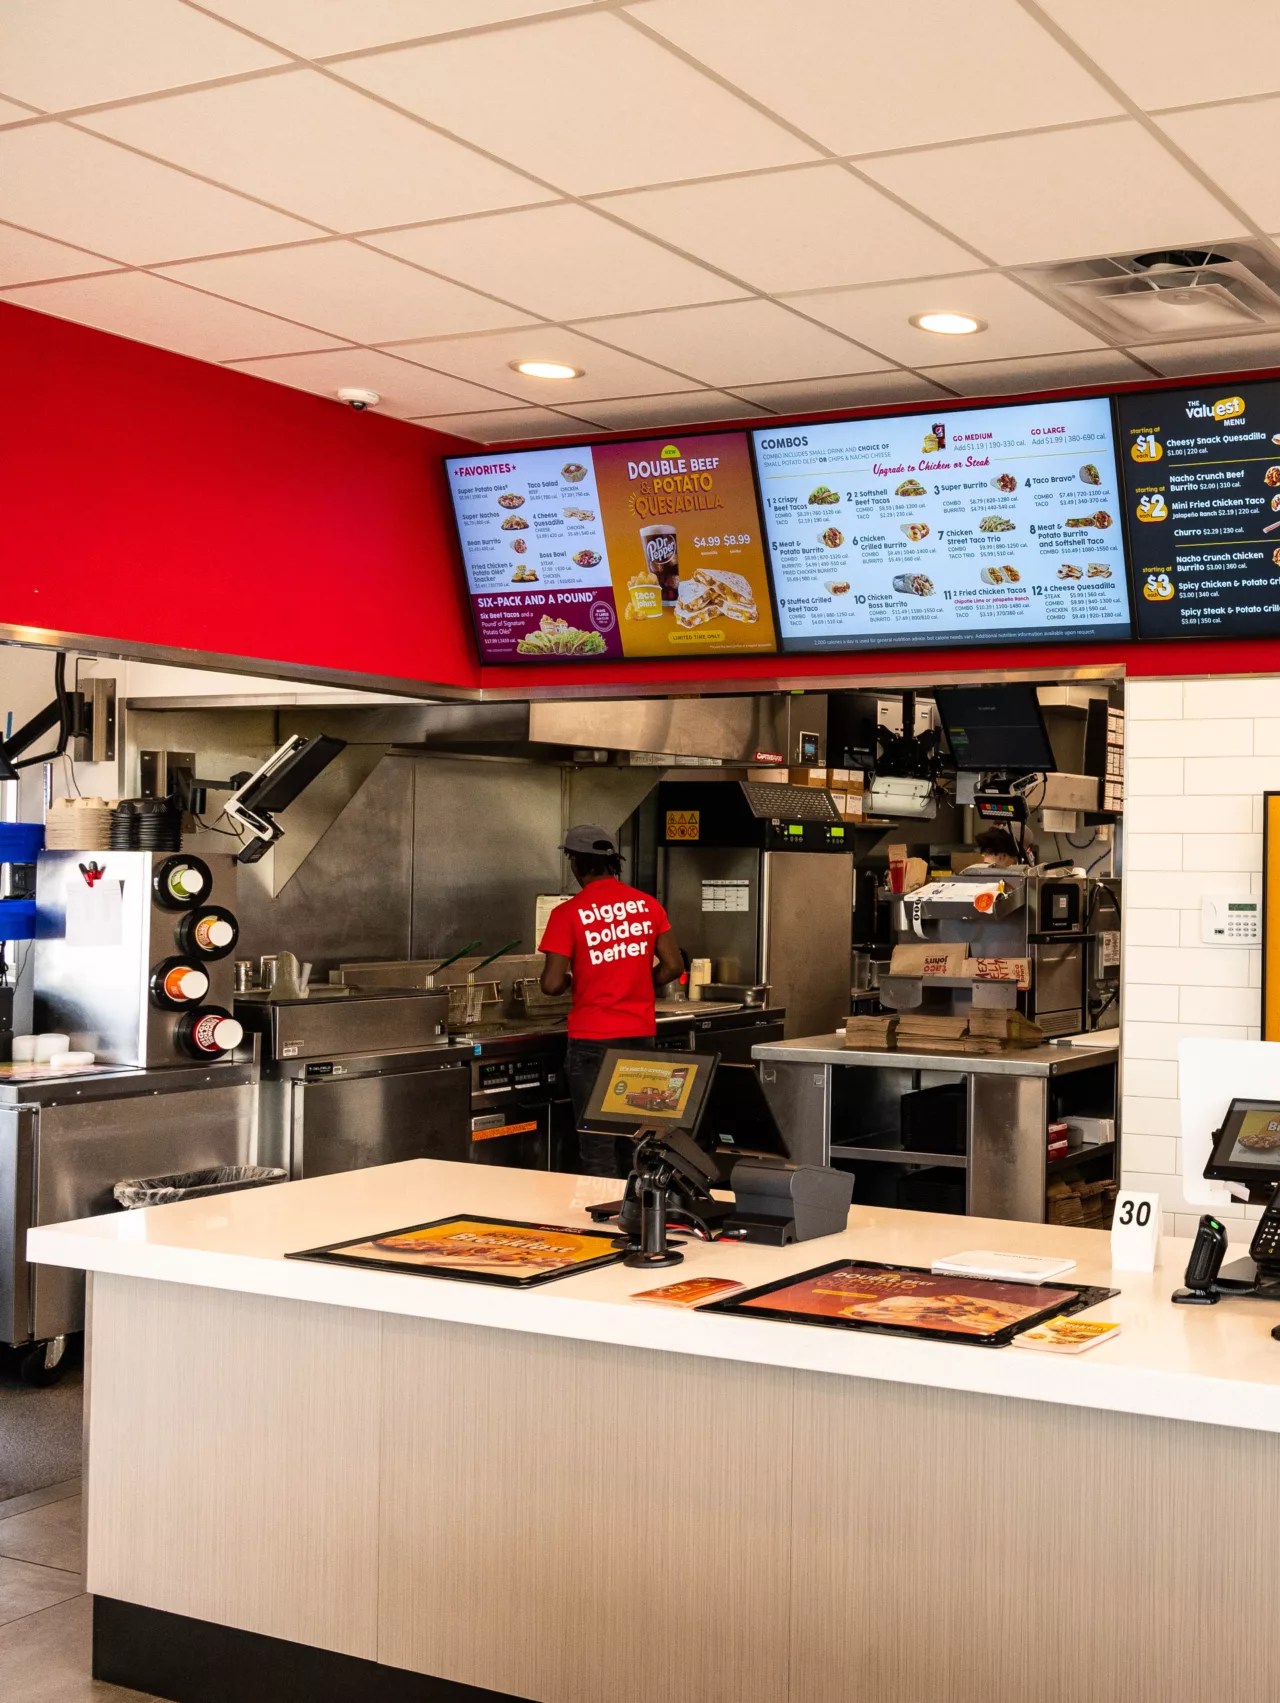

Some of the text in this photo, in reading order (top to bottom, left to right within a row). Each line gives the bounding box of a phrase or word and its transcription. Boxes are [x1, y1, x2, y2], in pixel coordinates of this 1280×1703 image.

[761, 436, 808, 449] COMBOS
[965, 433, 992, 441] MEDIUM
[1167, 432, 1266, 447] Cheesy Snack Quesadilla
[1137, 435, 1156, 458] $1
[460, 463, 511, 477] FAVORITES
[628, 458, 719, 479] DOUBLE BEEF
[873, 463, 905, 477] Upgrade
[907, 464, 916, 472] to
[918, 460, 951, 471] Chicken
[965, 456, 990, 468] Steak
[1196, 472, 1224, 481] Crunch
[1227, 470, 1244, 478] Beef
[641, 473, 713, 494] & POTATO
[934, 485, 940, 495] 3
[941, 483, 962, 492] Super
[1025, 478, 1031, 488] 4
[1171, 483, 1198, 492] Burrito
[635, 495, 723, 518] QUESADILLA
[767, 498, 772, 507] 1
[1141, 494, 1166, 518] $2
[1172, 497, 1265, 510] Mini Fried Chicken Taco
[656, 538, 667, 549] Dr
[694, 534, 750, 547] $4.99 $8.99
[1176, 552, 1263, 563] Nacho Crunch Chicken
[1032, 586, 1042, 595] 12
[1077, 582, 1115, 590] Quesadilla
[1148, 574, 1170, 596] $3
[1179, 582, 1199, 590] Spicy
[1201, 580, 1232, 588] Chicken
[1242, 579, 1268, 587] Potato
[478, 596, 522, 607] SIX-PACK
[525, 595, 545, 605] AND
[548, 594, 556, 603] A
[578, 900, 649, 926] bigger.
[585, 921, 653, 946] bolder.
[1119, 1200, 1151, 1226] 30
